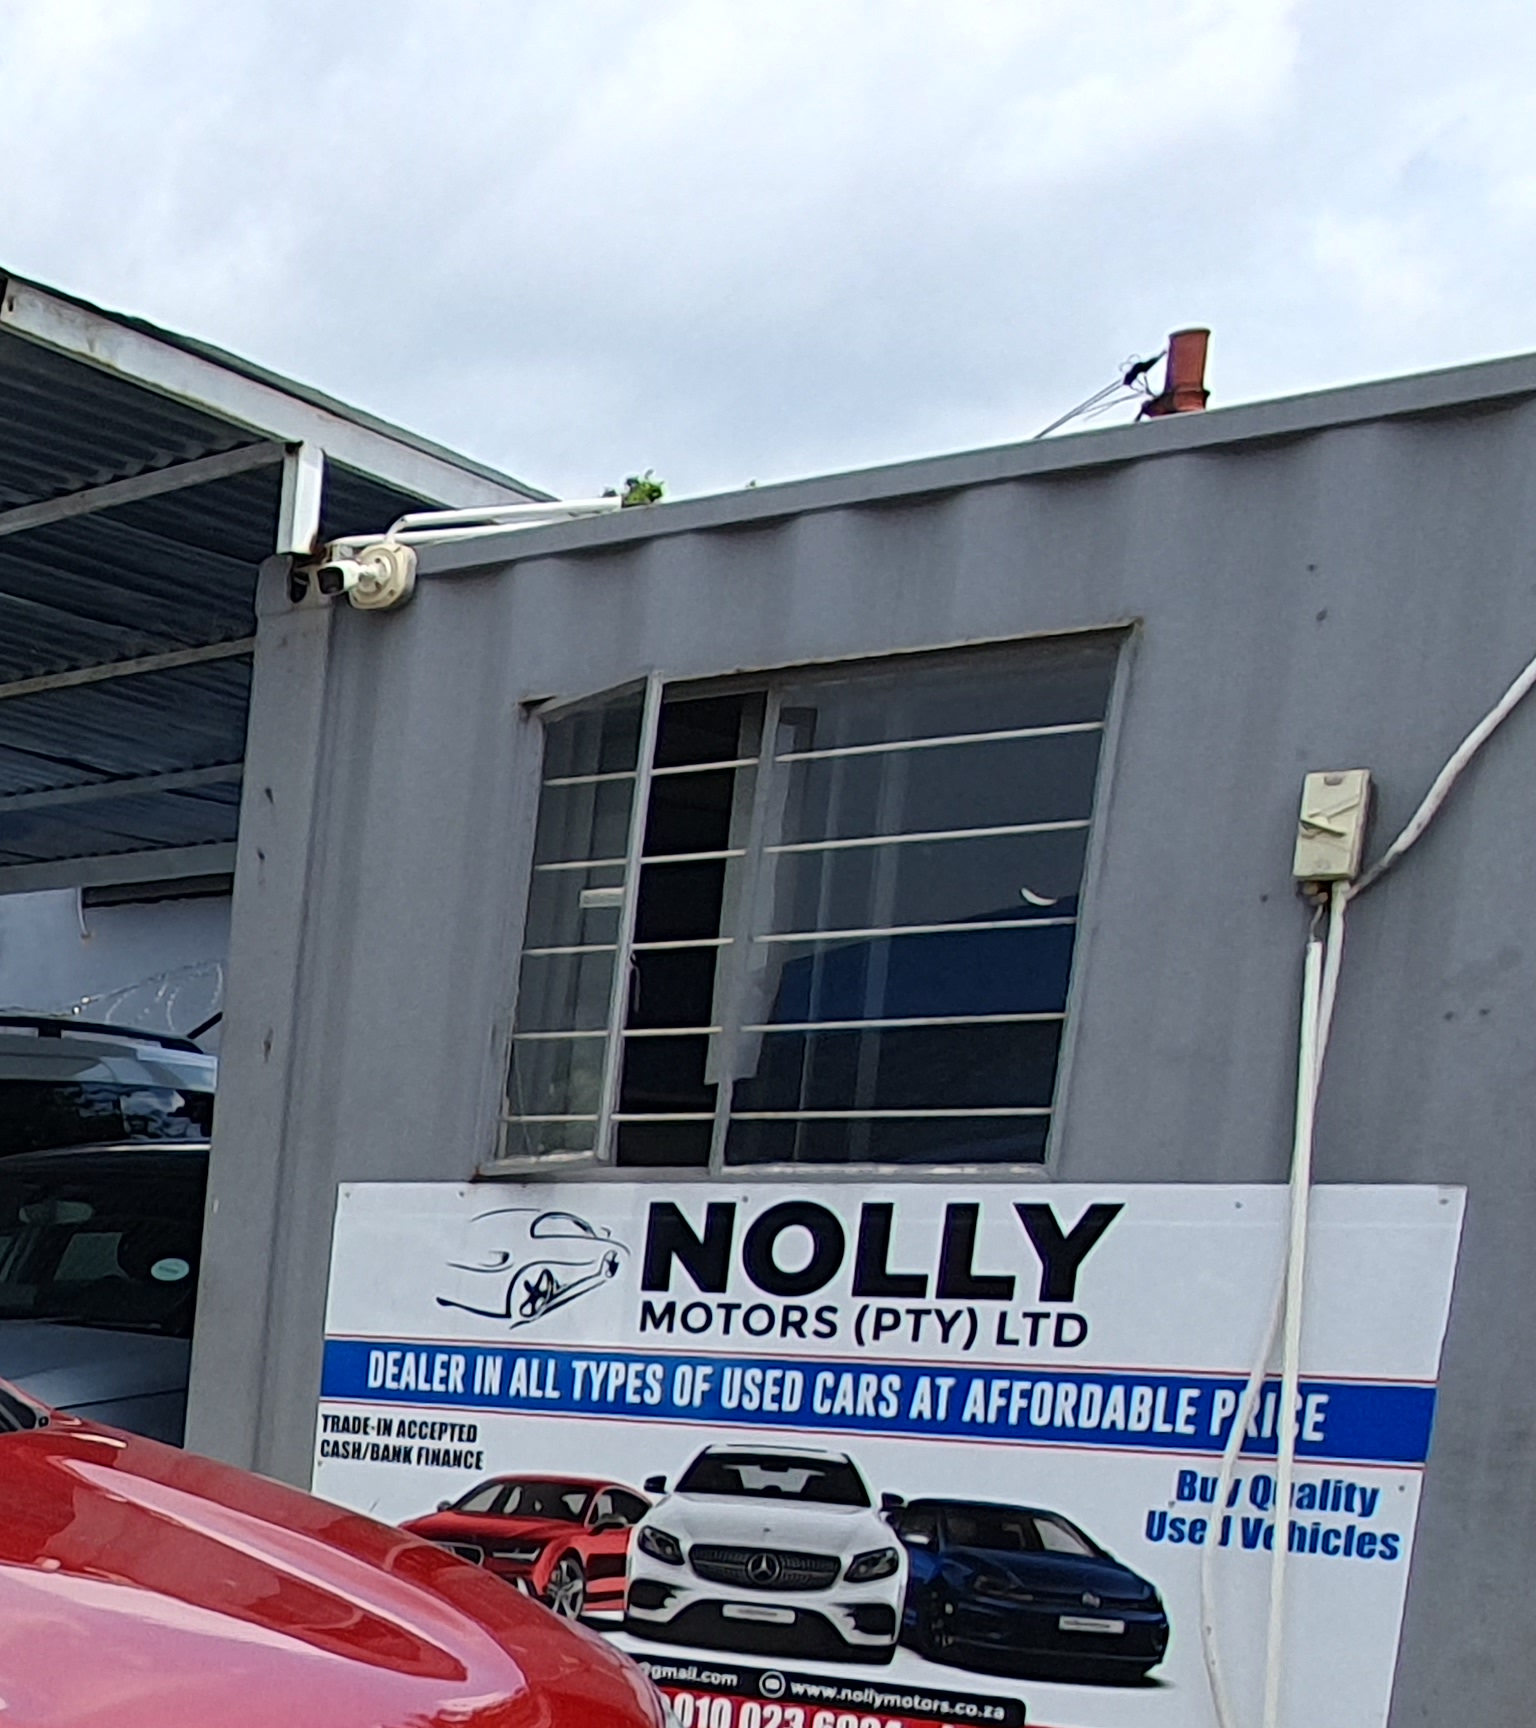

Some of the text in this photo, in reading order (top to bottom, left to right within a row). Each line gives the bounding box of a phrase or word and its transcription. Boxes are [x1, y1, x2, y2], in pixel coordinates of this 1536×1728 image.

[641, 1199, 1126, 1303] NOLLY
[639, 1300, 1089, 1351] MOTORS (PTY) LTD
[366, 1349, 466, 1395] DEALER
[473, 1355, 502, 1396] IN
[508, 1357, 561, 1400] ALL
[571, 1360, 663, 1406] TYPES
[672, 1364, 715, 1409] OF
[720, 1366, 804, 1413] USED
[812, 1370, 902, 1419] CARS
[908, 1375, 956, 1422] AT
[961, 1377, 1201, 1435] AFFORDABLE
[320, 1413, 478, 1444] TRADE-IN ACCEPTED
[319, 1439, 485, 1471] CASH/BANK FINANCE
[1249, 1473, 1381, 1518] Qality
[789, 1680, 1005, 1721] www.nollymotors.co.za
